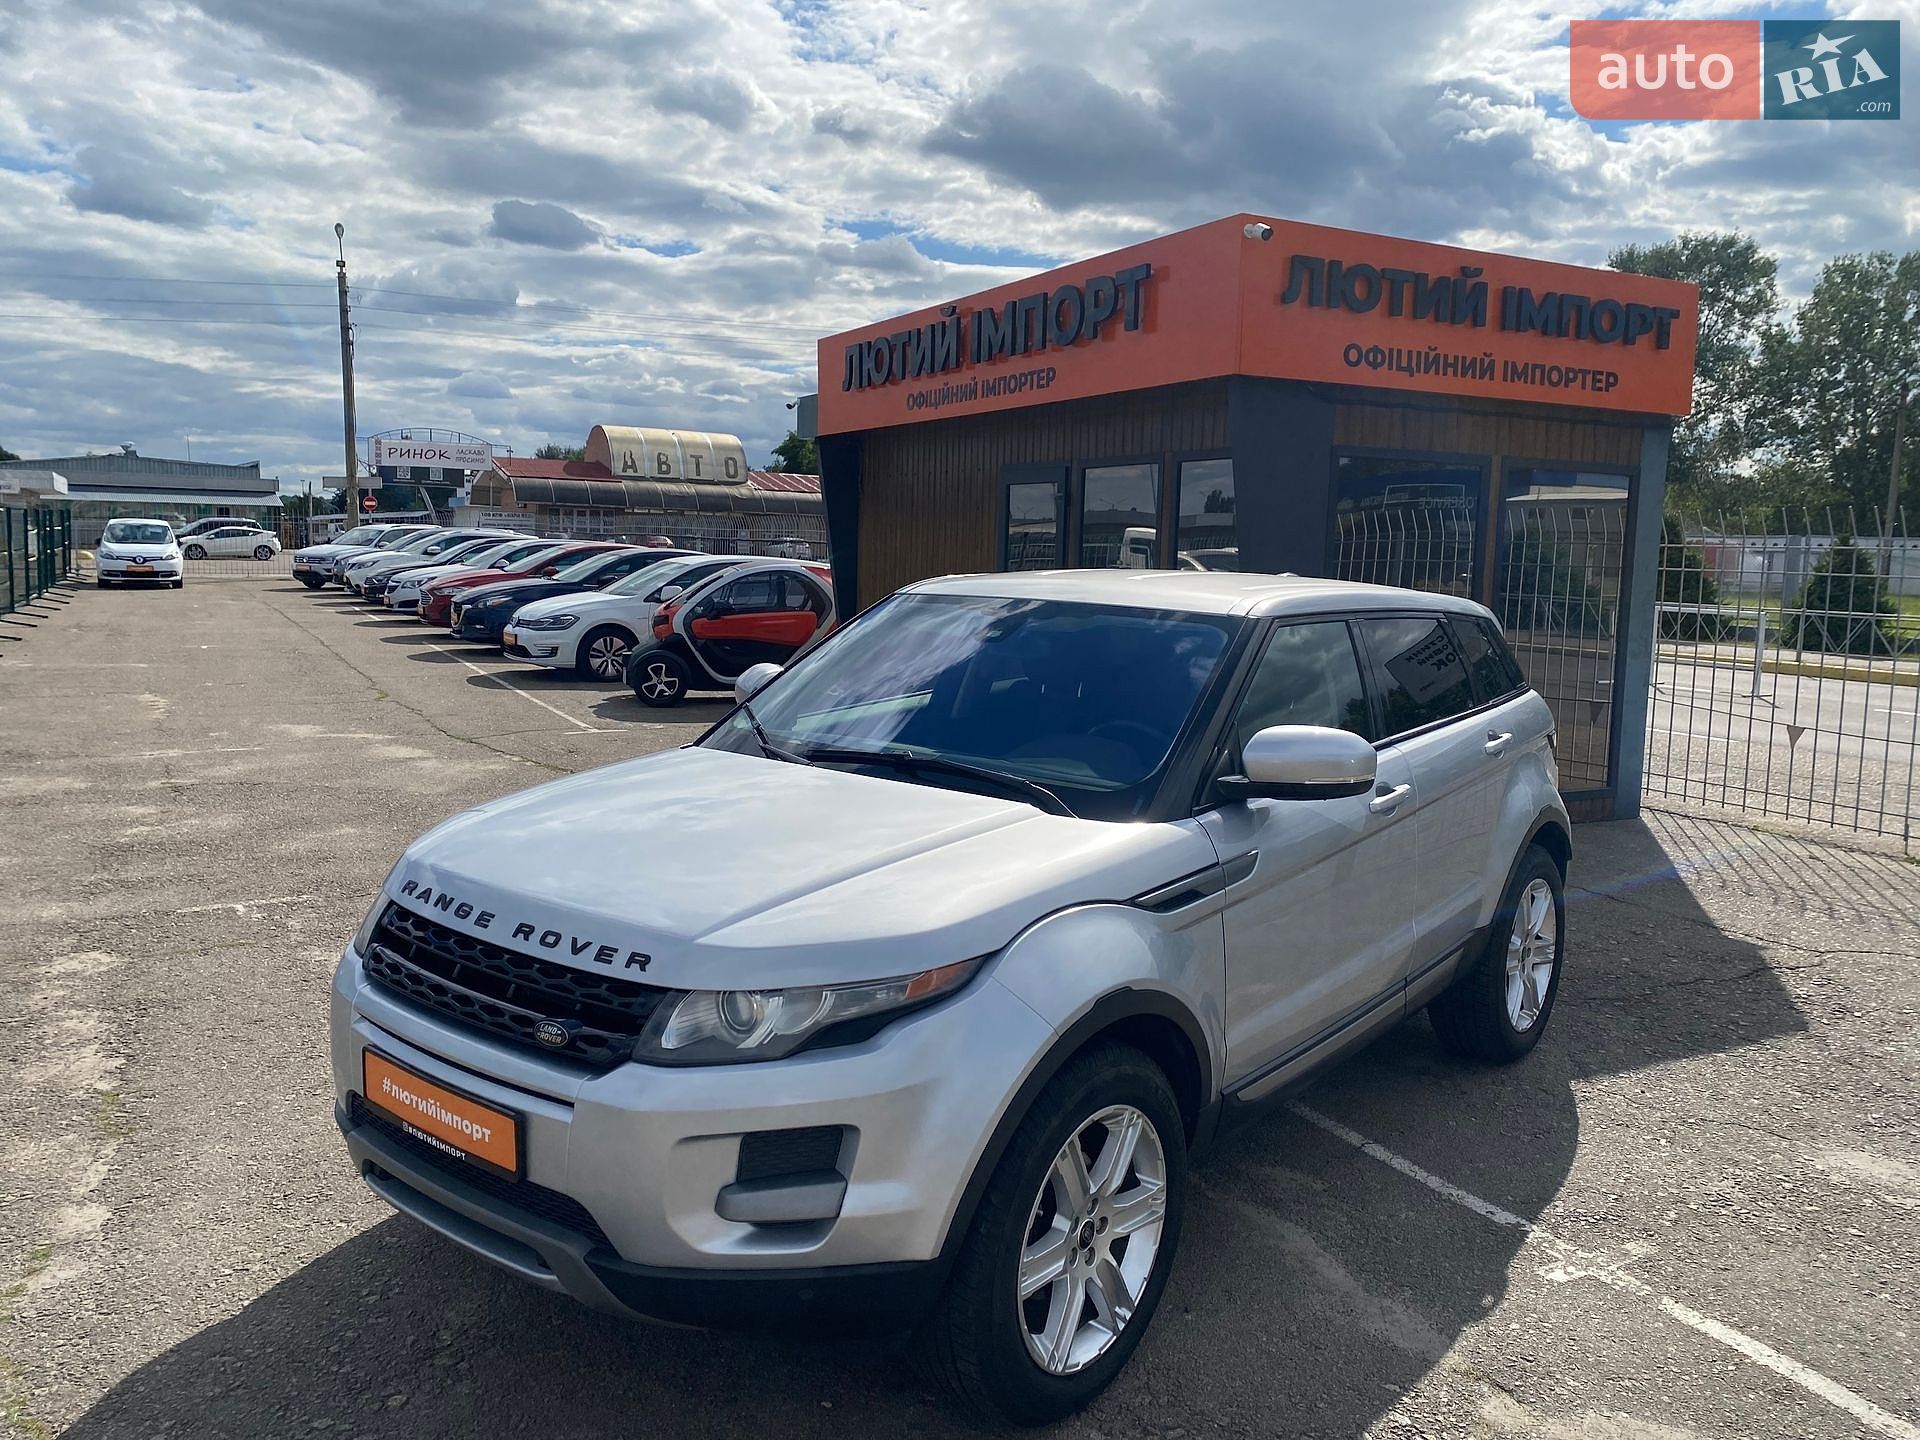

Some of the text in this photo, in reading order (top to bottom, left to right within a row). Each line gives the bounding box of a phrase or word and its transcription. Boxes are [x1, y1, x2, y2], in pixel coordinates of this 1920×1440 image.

[842, 263, 1152, 392] ЛЮТИЙ ІМПОРТ
[1281, 253, 1680, 351] ЛЮТИЙ ІМПОРТ
[906, 366, 1056, 411] ОФІЦІЙНИЙ ІМПОРТЕР
[1343, 343, 1619, 393] ОФІЦІЙНИЙ ІМПОРТЕР
[387, 447, 451, 460] РИНОК
[621, 450, 739, 479] АВТО
[401, 879, 652, 973] RANGE ROVER
[382, 1077, 491, 1143] #лютийімпорт
